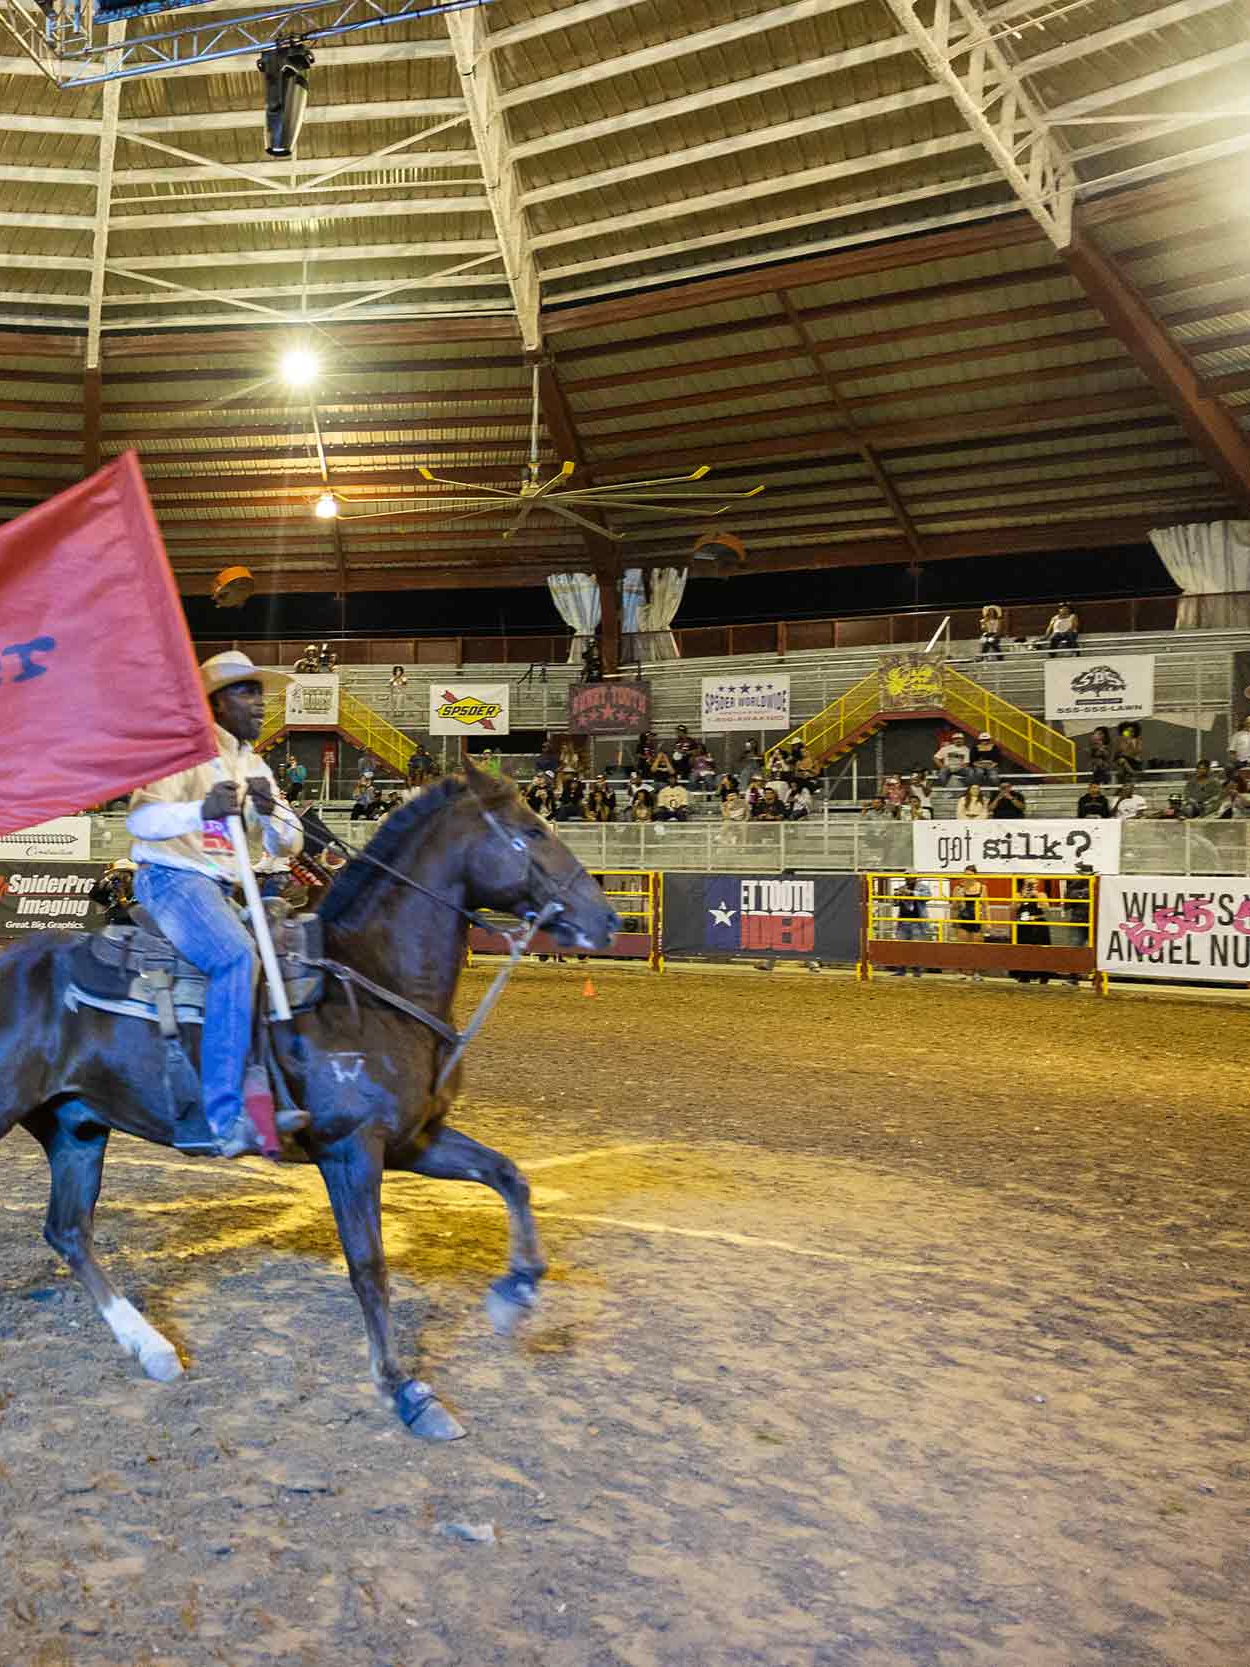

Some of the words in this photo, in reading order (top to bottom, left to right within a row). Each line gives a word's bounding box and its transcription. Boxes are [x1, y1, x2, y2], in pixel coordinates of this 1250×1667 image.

[938, 830, 972, 868] got
[983, 830, 1092, 865] silk?
[16, 897, 90, 916] Imaging
